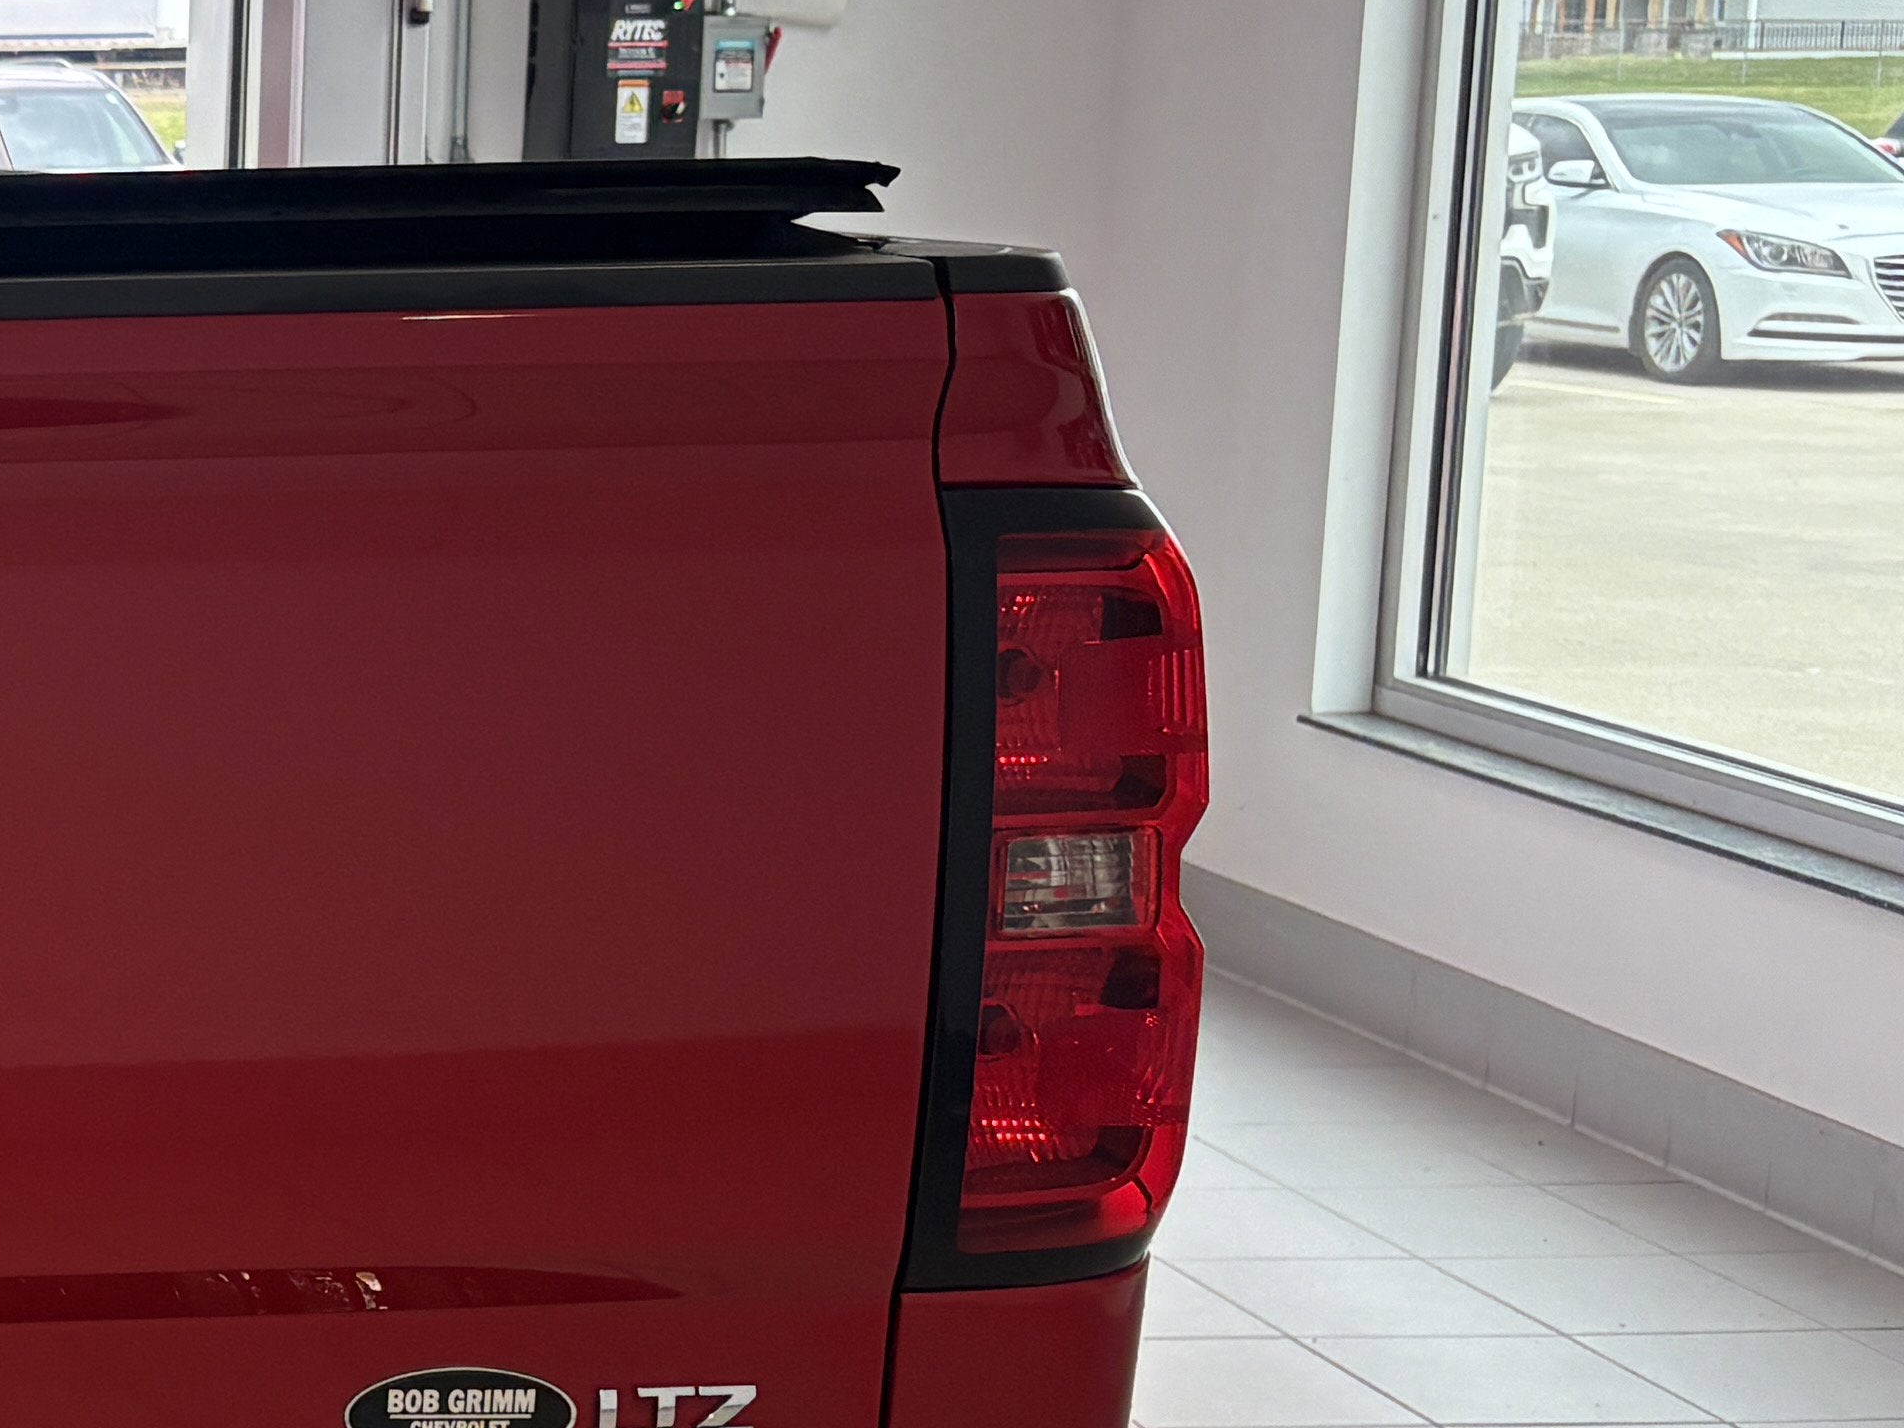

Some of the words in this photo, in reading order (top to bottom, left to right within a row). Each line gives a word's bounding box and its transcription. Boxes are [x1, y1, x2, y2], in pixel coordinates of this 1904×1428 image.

[610, 18, 667, 42] RYTEC
[387, 1388, 440, 1414] BOB
[447, 1388, 537, 1414] GRIMM
